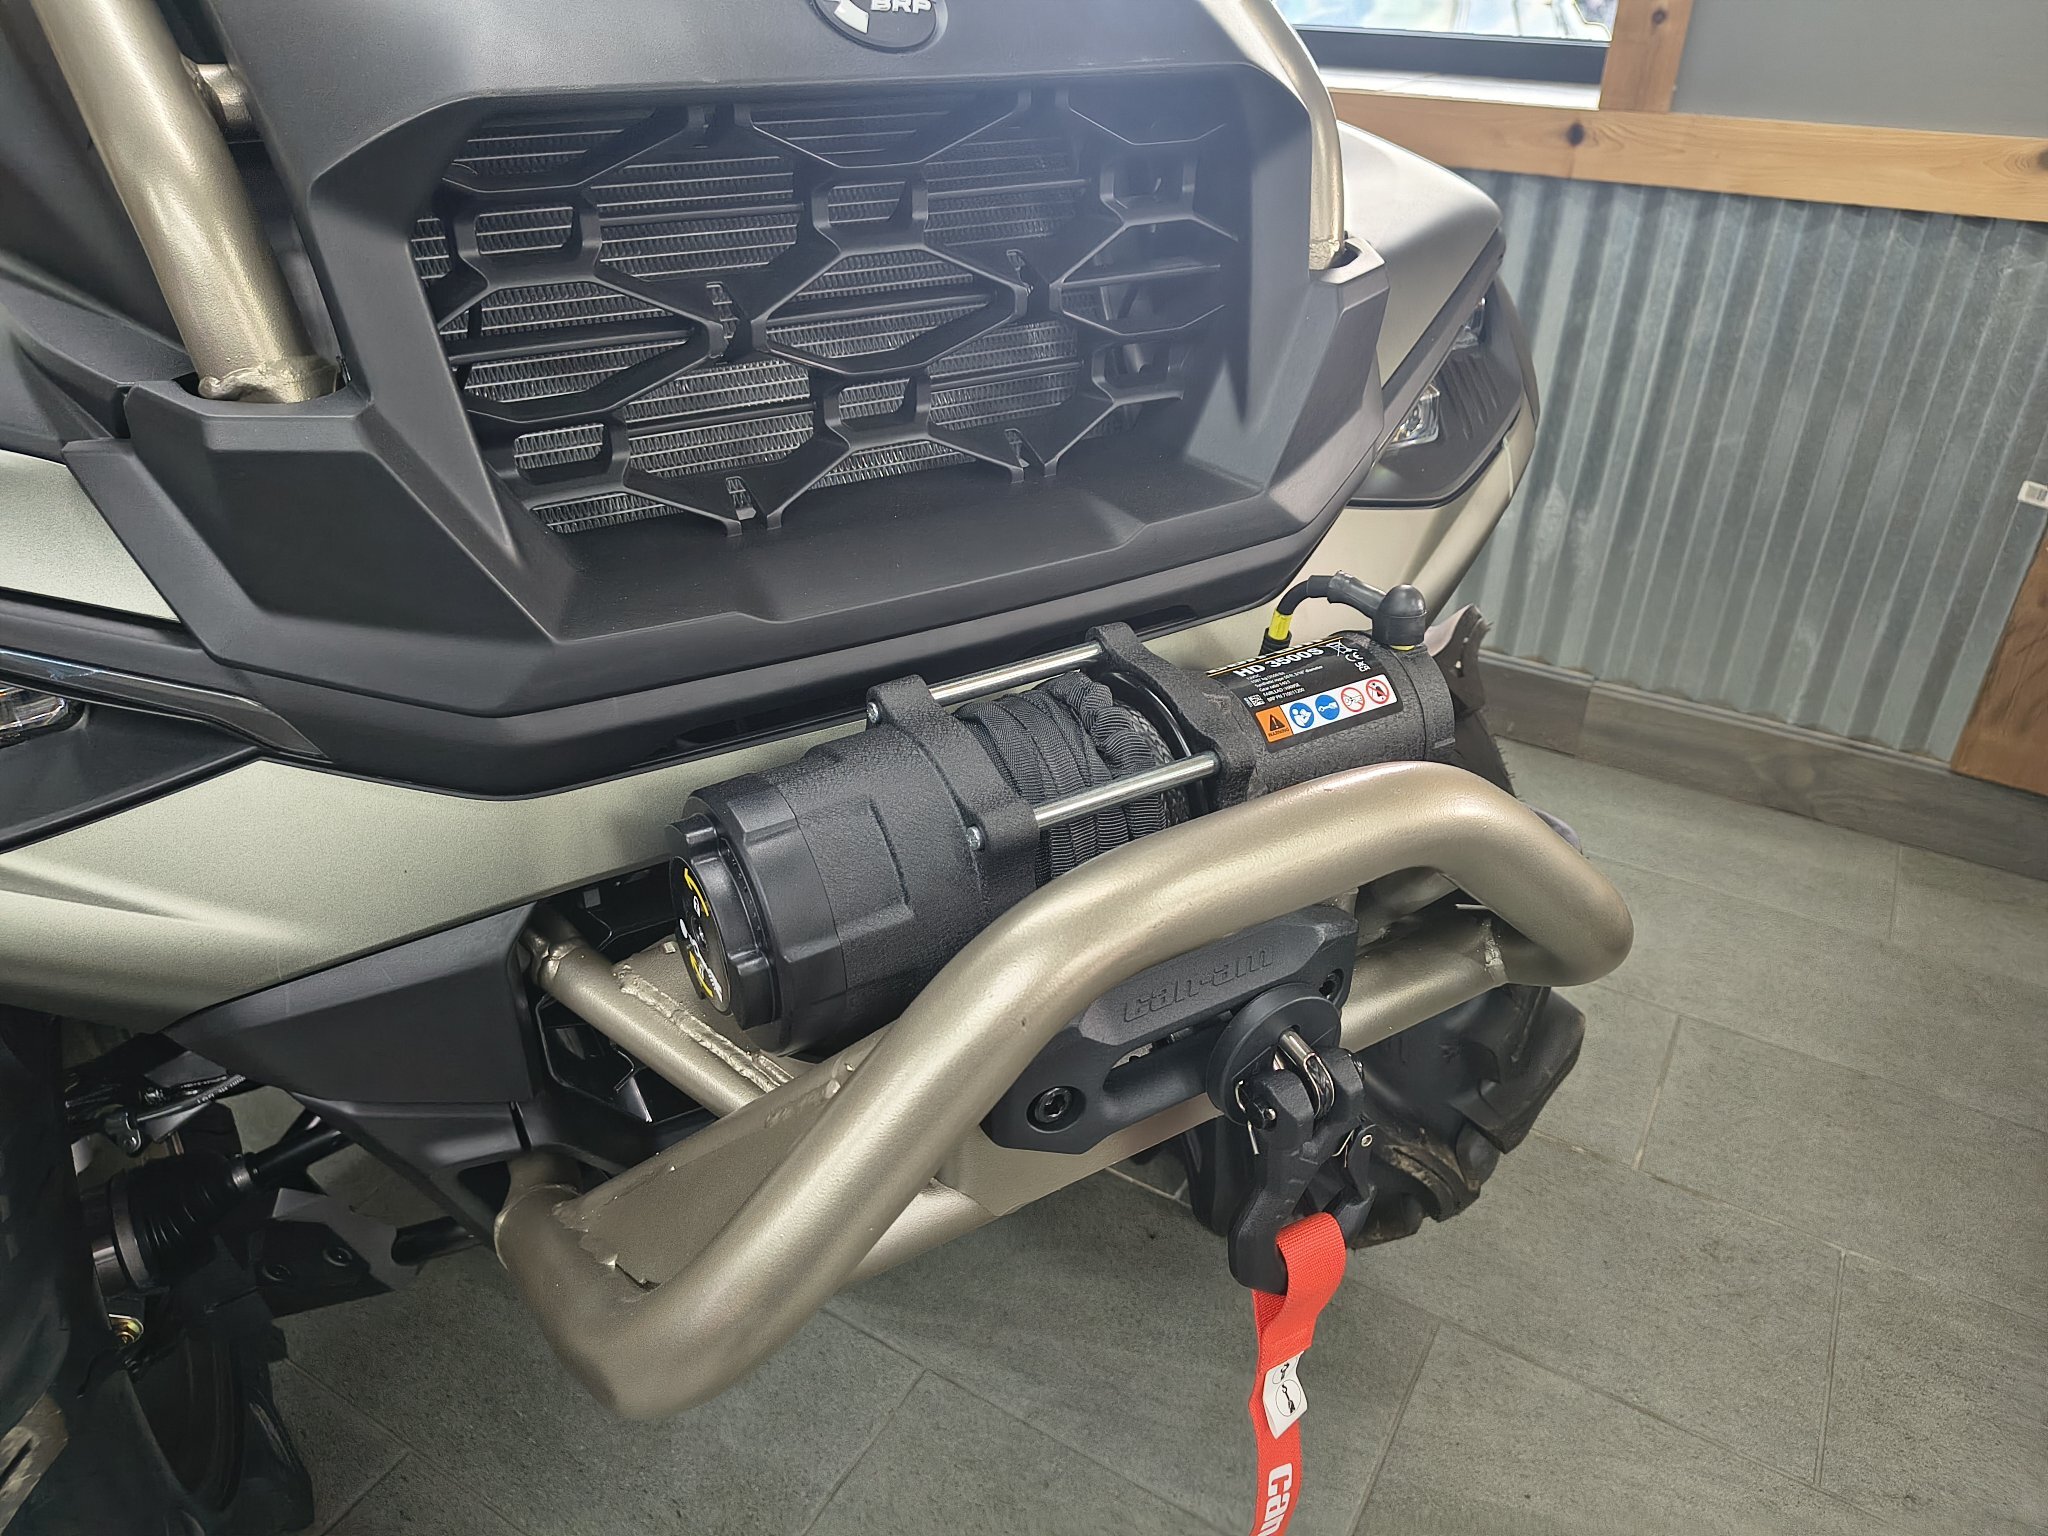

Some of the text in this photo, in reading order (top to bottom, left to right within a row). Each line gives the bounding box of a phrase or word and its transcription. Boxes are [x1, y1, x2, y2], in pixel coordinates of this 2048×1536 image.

[871, 0, 931, 13] BRP
[1233, 664, 1265, 677] HD
[1265, 647, 1324, 668] 3500S
